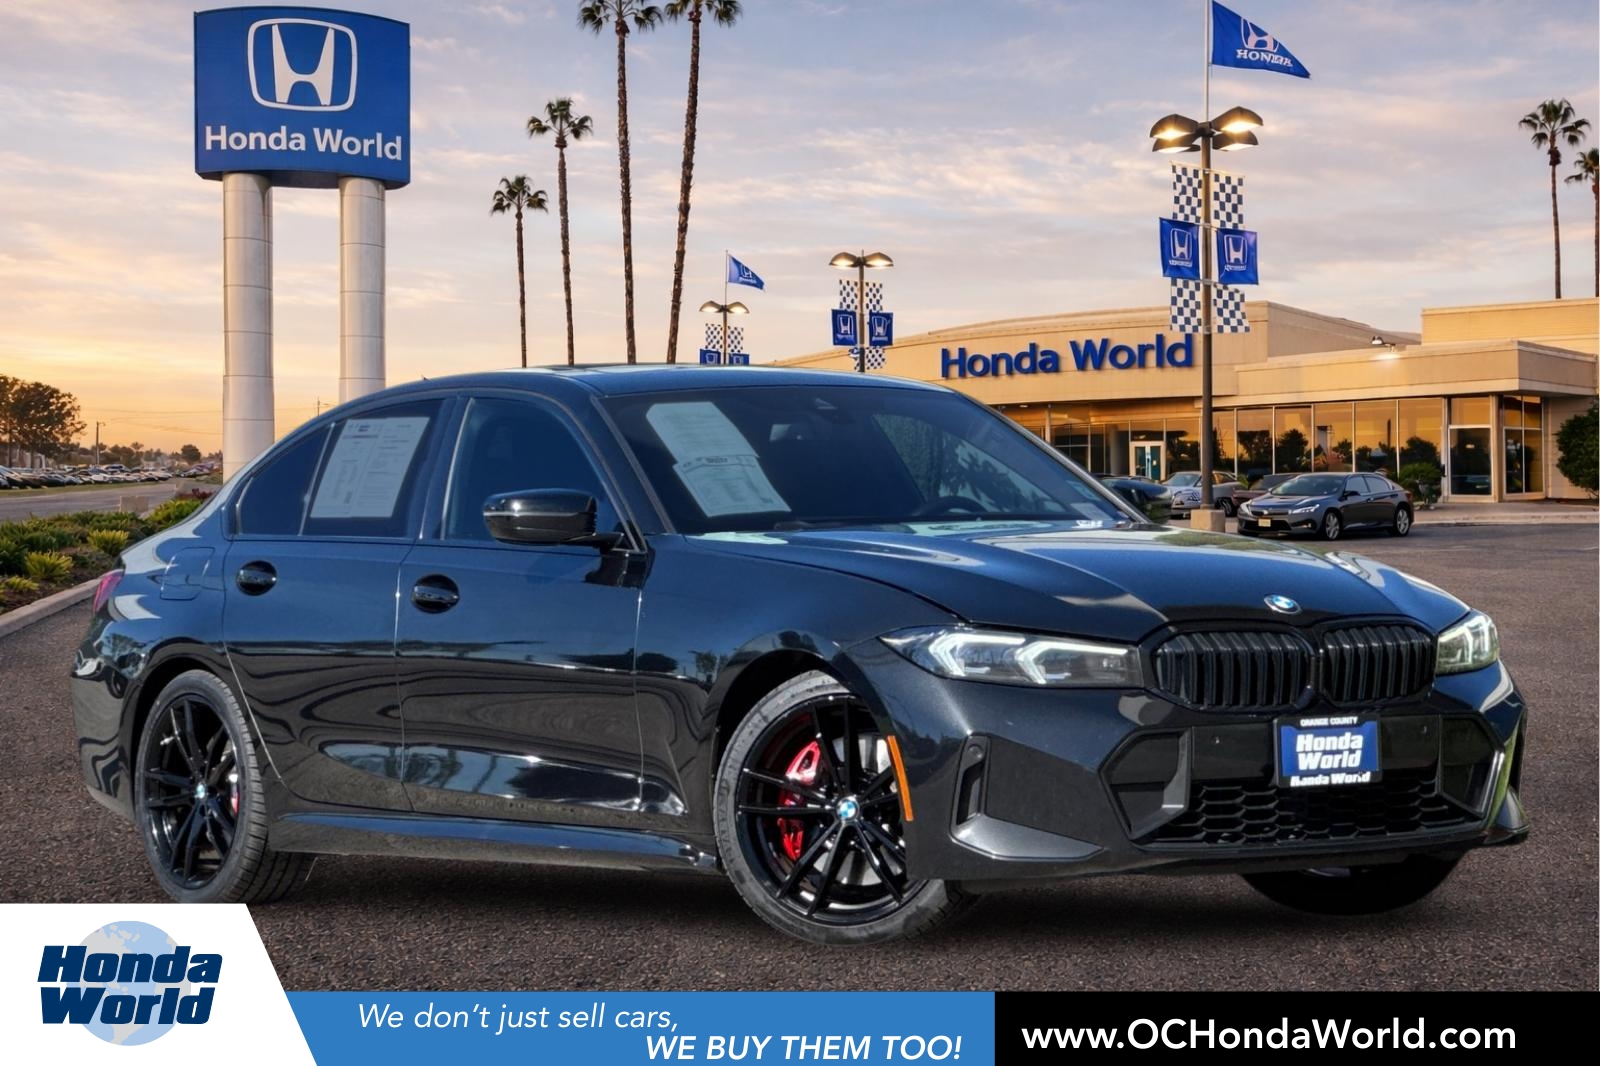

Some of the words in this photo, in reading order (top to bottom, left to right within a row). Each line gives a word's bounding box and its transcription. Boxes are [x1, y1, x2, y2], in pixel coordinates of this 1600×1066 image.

[205, 125, 306, 151] Honda
[312, 127, 402, 160] World
[940, 342, 1060, 379] Honda
[1069, 332, 1194, 371] World
[1300, 717, 1329, 727] ORANGE
[1330, 716, 1358, 726] COUNTY
[1296, 732, 1364, 752] Honda
[1298, 750, 1362, 770] World
